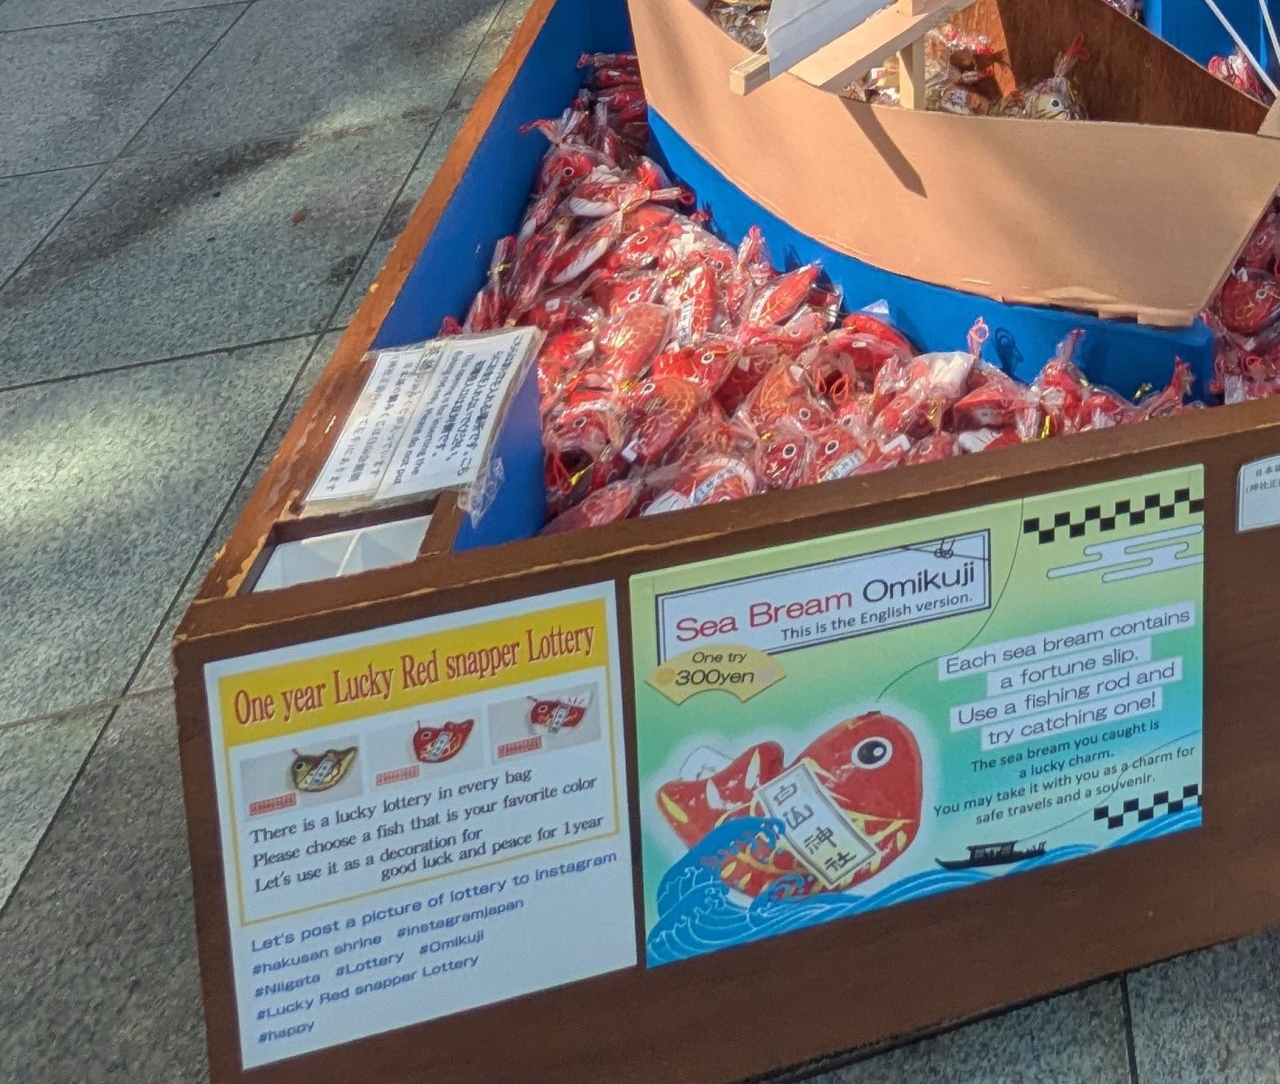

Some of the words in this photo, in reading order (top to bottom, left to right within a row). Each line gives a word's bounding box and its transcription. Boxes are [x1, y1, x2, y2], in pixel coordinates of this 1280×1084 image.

[675, 615, 738, 643] Sea
[749, 591, 853, 629] Bream
[862, 561, 976, 604] Omikuji
[781, 625, 812, 642] This
[815, 621, 829, 635] is
[831, 614, 856, 630] the
[860, 603, 912, 627] English
[915, 592, 975, 614] version.
[692, 651, 724, 664] One
[727, 650, 748, 664] try
[946, 651, 997, 674] Each
[1002, 645, 1037, 661] sea
[1042, 629, 1104, 653] bream
[1109, 610, 1191, 638] contains
[1000, 676, 1013, 689] a
[1020, 658, 1096, 684] fortune
[1101, 648, 1139, 669] slip.
[235, 690, 275, 725] One
[281, 681, 327, 723] year
[333, 664, 394, 706] Lucky
[401, 650, 440, 688] Red
[446, 639, 520, 681] snapper
[526, 623, 596, 663] Lottery
[674, 668, 755, 687] 300yen
[958, 707, 998, 725] Use
[1003, 701, 1017, 715] a
[1024, 683, 1090, 711] fishing
[1096, 671, 1130, 694] rod
[1136, 662, 1175, 685] and
[971, 760, 997, 773] The
[1000, 753, 1023, 766] sea
[1027, 741, 1070, 760] bream
[1074, 736, 1098, 751] you
[1101, 725, 1147, 743] caught
[1150, 720, 1160, 731] is
[988, 728, 1015, 746] try
[1020, 706, 1108, 737] catching
[1113, 691, 1156, 716] one!
[934, 803, 961, 818] You
[964, 797, 993, 813] may
[996, 787, 1025, 803] take
[1029, 782, 1040, 794] it
[1041, 772, 1072, 791] with
[1075, 769, 1100, 787] you
[1103, 764, 1118, 776] as
[1121, 762, 1130, 772] a
[1132, 751, 1173, 769] charm
[1176, 745, 1196, 759] for
[1019, 769, 1027, 779] a
[1031, 760, 1065, 776] lucky
[1068, 750, 1115, 768] charm.
[250, 820, 297, 844] There
[303, 817, 316, 832] is
[320, 818, 330, 829] a
[335, 804, 377, 826] lucky
[383, 791, 432, 814] lottery
[438, 785, 453, 799] in
[458, 775, 499, 797] every
[505, 766, 532, 786] bag
[252, 846, 301, 868] Please
[306, 835, 357, 856] choose
[362, 830, 371, 842] a
[376, 821, 405, 838] fish
[410, 812, 441, 831] that
[446, 807, 459, 822] is
[464, 800, 498, 822] your
[502, 784, 559, 809] favorite
[562, 775, 598, 794] color
[773, 782, 857, 873] 白山神社
[976, 810, 1004, 825] safe
[1007, 797, 1052, 817] travels
[1056, 791, 1081, 805] and
[1084, 788, 1092, 798] a
[1095, 772, 1156, 796] souvenir.
[255, 872, 291, 893] Let's
[297, 868, 322, 883] use
[326, 861, 338, 875] it
[343, 857, 361, 871] as
[365, 854, 375, 866] a
[380, 834, 457, 863] decoration
[462, 827, 484, 844] for
[380, 859, 417, 882] good
[422, 850, 454, 870] luck
[458, 842, 487, 862] and
[491, 832, 532, 856] peace
[537, 826, 557, 842] for
[251, 930, 295, 953] Let's
[300, 920, 341, 943] post
[346, 917, 356, 929] a
[361, 899, 422, 927] picture
[428, 893, 444, 908] of
[450, 879, 506, 903] lottery
[512, 873, 529, 887] to
[251, 948, 329, 976] #hakusan
[333, 933, 382, 957] shrine
[255, 972, 321, 998] #Niigata
[335, 951, 405, 978] #Lottery
[419, 930, 485, 956] #Omikuji
[257, 999, 314, 1021] #Lucky
[319, 987, 350, 1006] Red
[354, 972, 417, 999] snapper
[421, 955, 479, 978] Lottery
[257, 1020, 315, 1044] #happy
